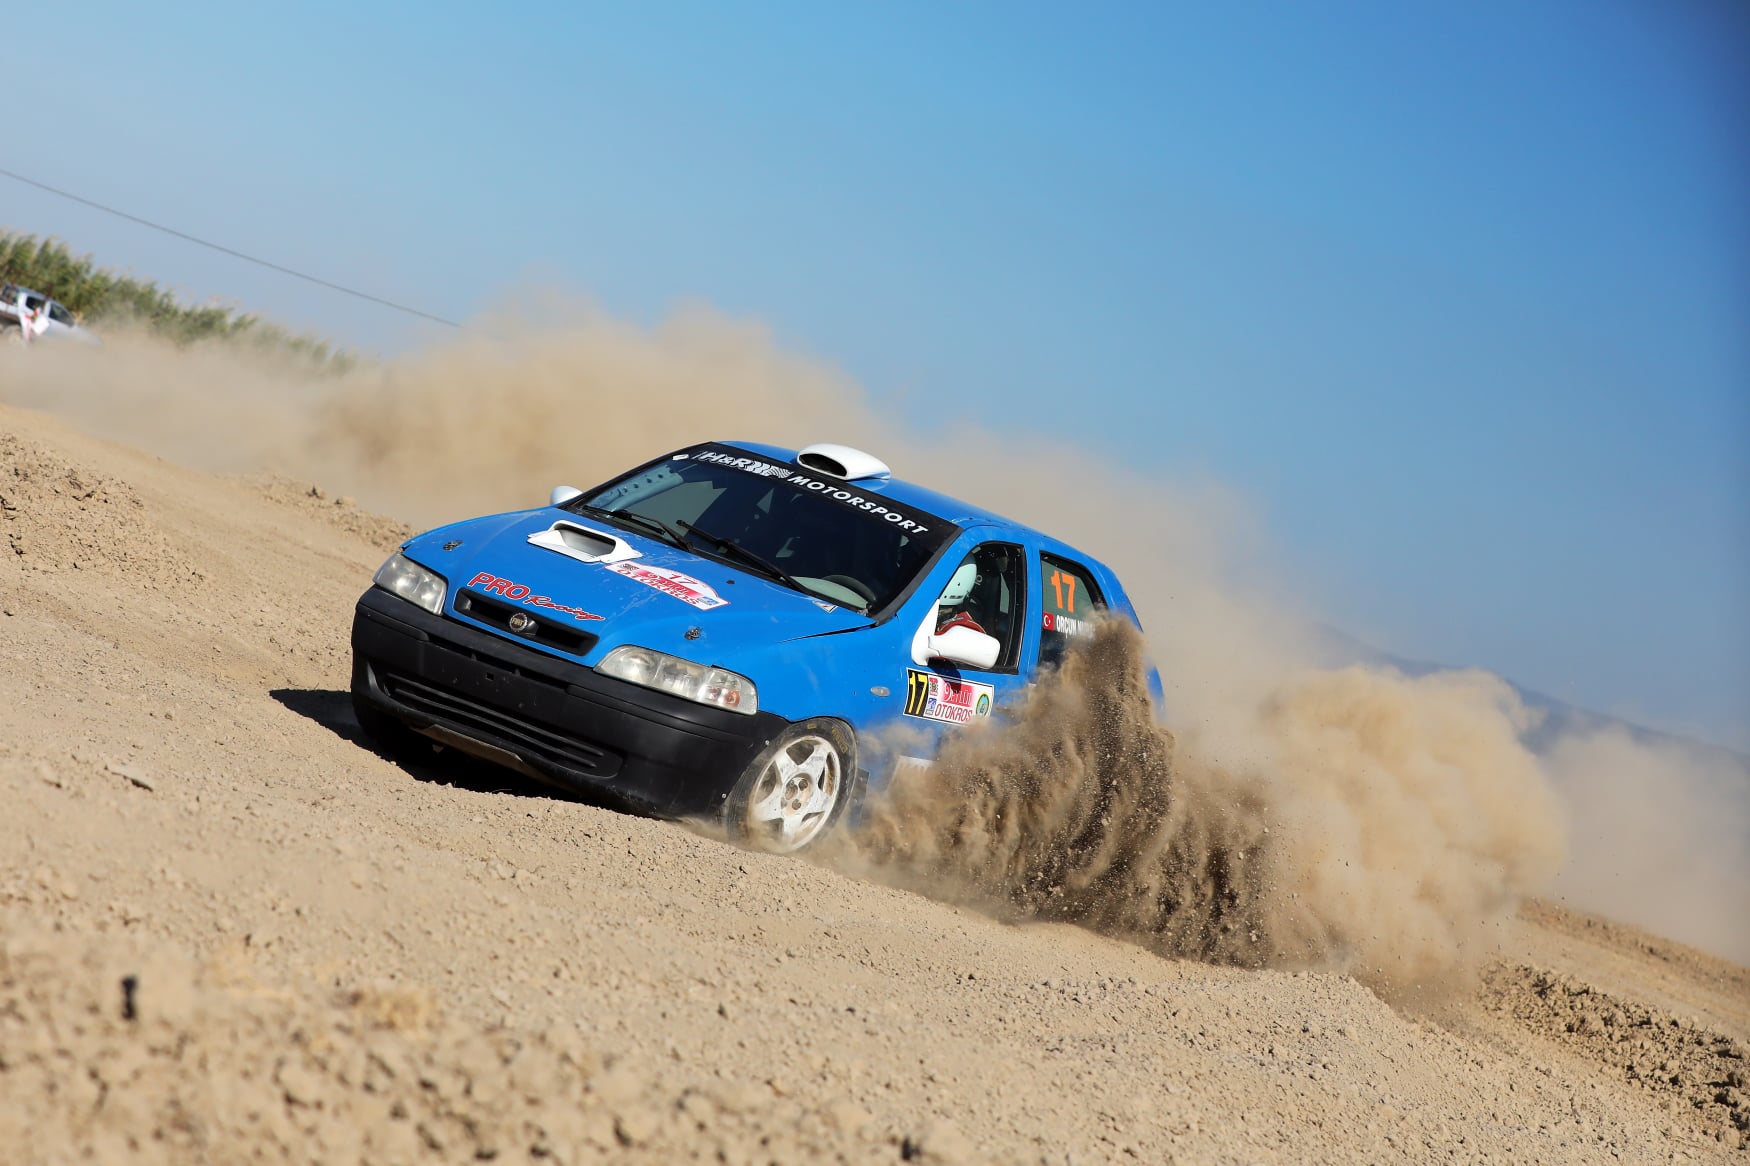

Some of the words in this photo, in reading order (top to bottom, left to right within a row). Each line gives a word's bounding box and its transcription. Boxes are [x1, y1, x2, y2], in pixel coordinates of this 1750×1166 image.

[787, 476, 929, 534] MOTORSPORT
[467, 572, 531, 600] PRO
[523, 595, 605, 620] Racing
[617, 569, 699, 605] OTOKROS
[669, 573, 698, 585] 17
[1050, 570, 1075, 613] 17
[909, 672, 928, 715] 17
[943, 681, 952, 702] 9
[934, 703, 973, 722] OTOKROS
